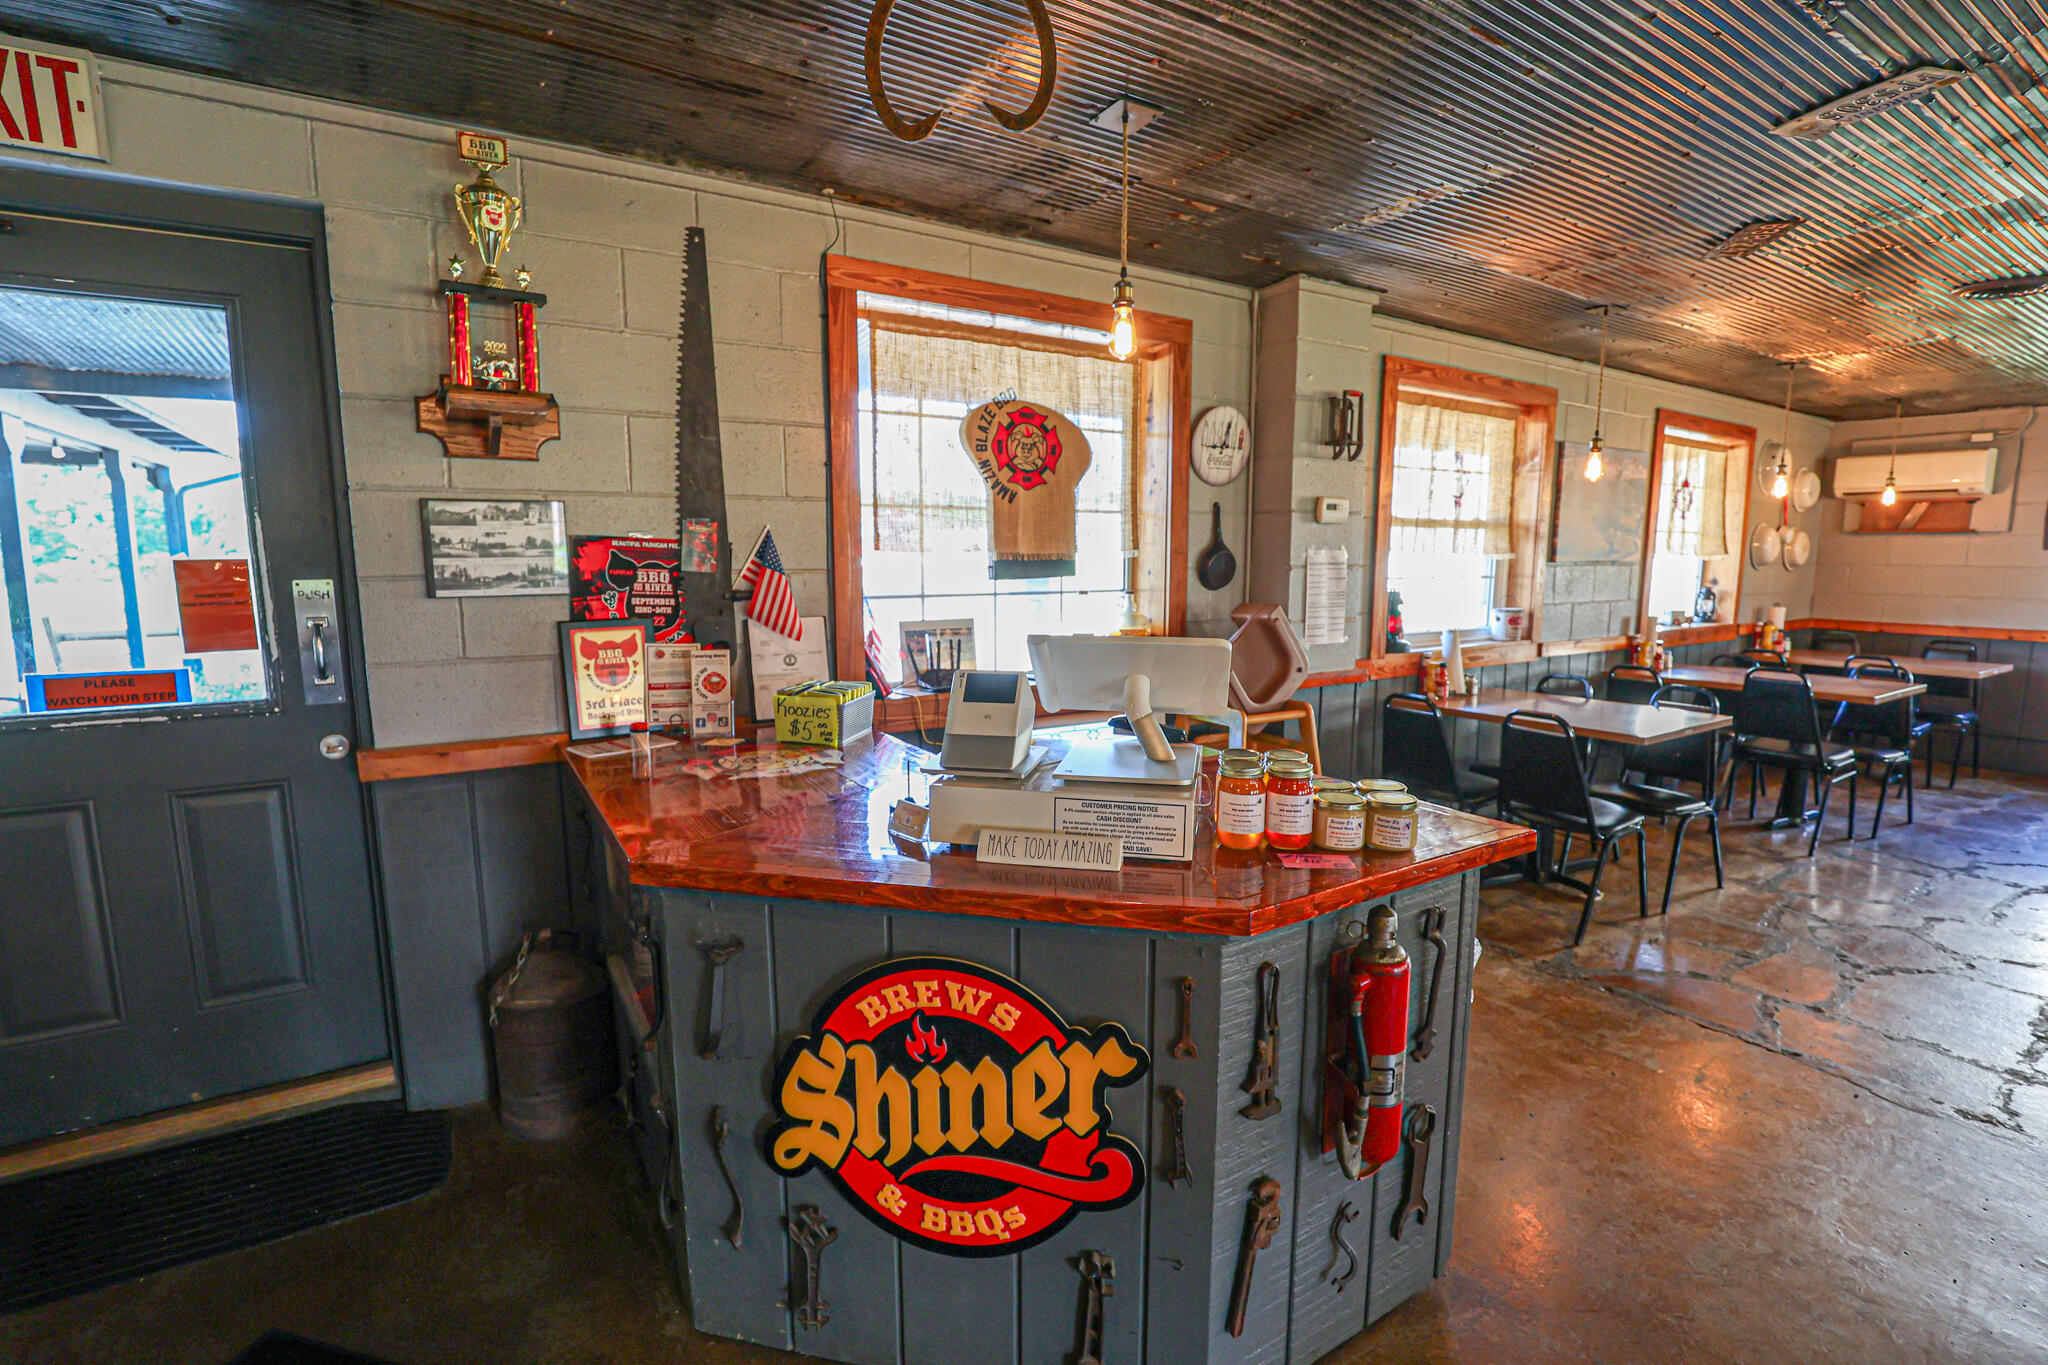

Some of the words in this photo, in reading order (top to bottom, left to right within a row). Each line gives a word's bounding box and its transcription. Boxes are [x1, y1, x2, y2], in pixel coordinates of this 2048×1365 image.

[484, 340, 507, 354] 2022
[975, 405, 997, 452] BLAZE
[992, 387, 1018, 410] BBQ
[637, 571, 670, 585] BBQ
[645, 584, 673, 592] RIVER
[631, 597, 675, 606] SEPTEMBER
[598, 648, 623, 658] BBQ
[84, 678, 136, 689] PLEASE
[46, 696, 98, 707] WATCH
[99, 694, 140, 705] YOUR
[143, 691, 176, 701] STEP
[585, 697, 606, 710] 3rd
[777, 697, 832, 719] Koozies
[986, 834, 1019, 858] MAKE
[1023, 836, 1058, 860] TODAY
[1061, 839, 1113, 864] AMAZING
[856, 980, 1022, 1032] BREWS
[774, 1033, 1138, 1169] Shiner
[877, 1183, 908, 1216] &
[921, 1203, 1027, 1240] BBQs
